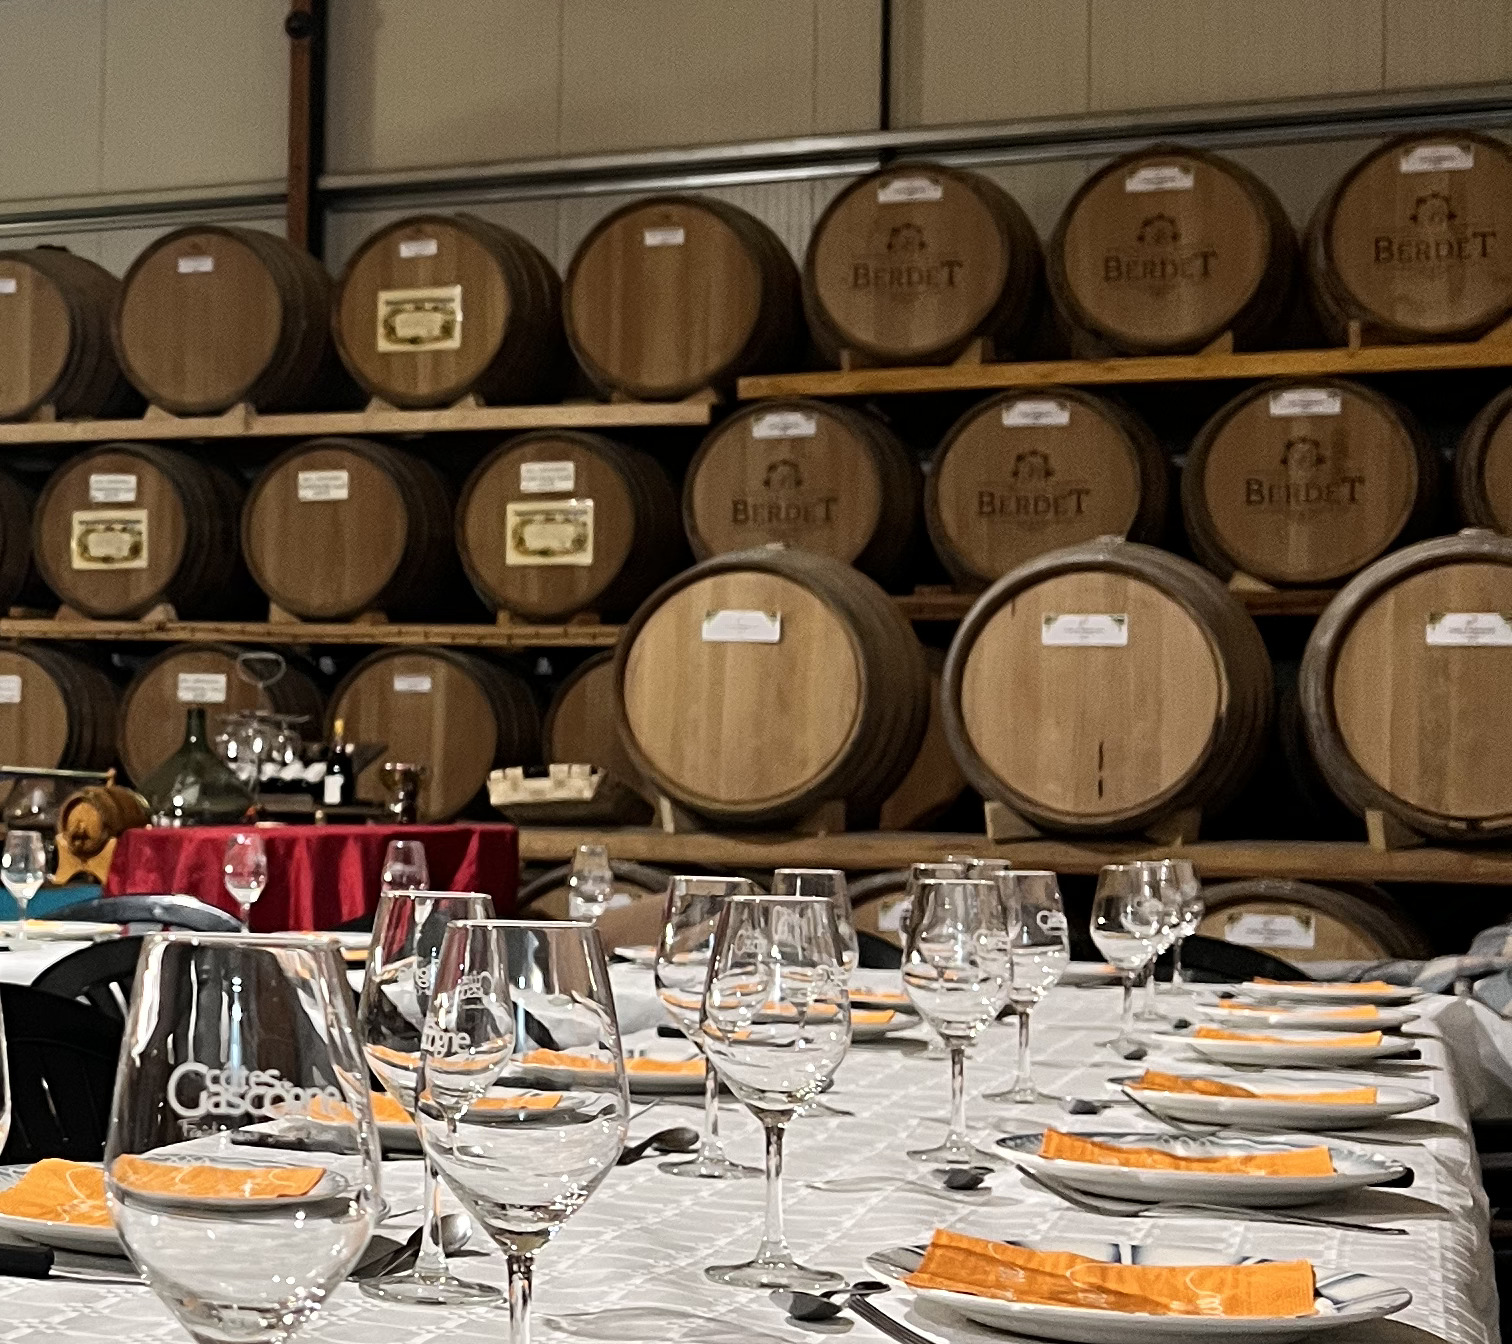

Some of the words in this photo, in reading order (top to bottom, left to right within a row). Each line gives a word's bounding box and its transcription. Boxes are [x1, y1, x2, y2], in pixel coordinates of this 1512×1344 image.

[1373, 231, 1497, 264] BERDET
[853, 260, 964, 290] BERDET
[1104, 250, 1218, 282] BERDET
[977, 488, 1091, 515] BERDET
[1245, 475, 1366, 506] BERDET
[732, 496, 838, 524] BERDET
